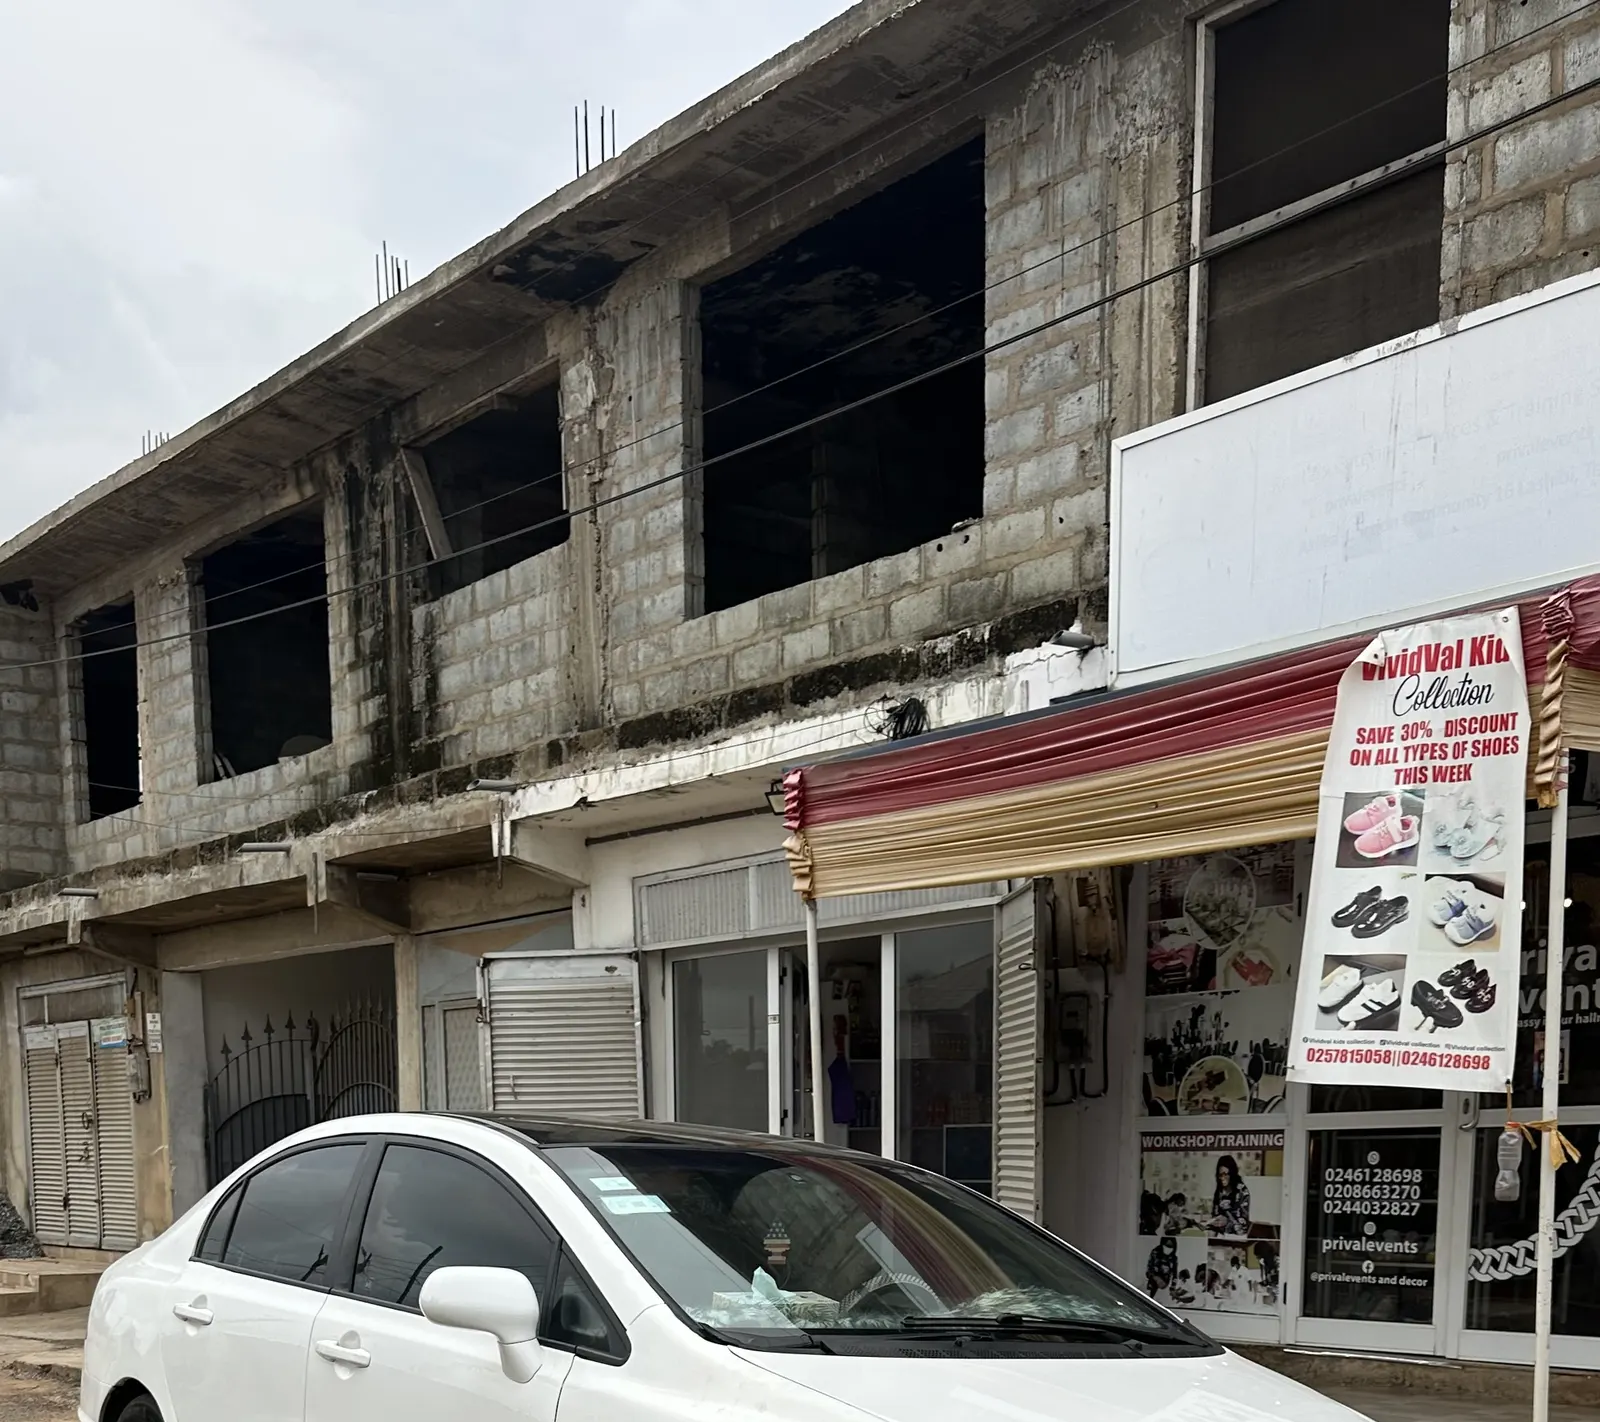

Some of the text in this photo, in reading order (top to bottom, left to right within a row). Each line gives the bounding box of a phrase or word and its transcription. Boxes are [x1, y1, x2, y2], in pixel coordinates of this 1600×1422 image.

[1392, 672, 1495, 717] Collection
[1356, 712, 1519, 745] SAVE 30% DISCOUNT
[1350, 735, 1519, 766] ON ALL TYPES OF SHOES
[1394, 763, 1473, 785] THIS WEEK
[1142, 1133, 1284, 1148] WORKSHOP/TRAINING
[1325, 1168, 1422, 1183] 0246128698
[1324, 1184, 1420, 1200] 0208663270
[1323, 1200, 1420, 1216] 0244032827
[1322, 1236, 1418, 1254] privalevents
[1310, 1271, 1428, 1286] @privalevents and decor
